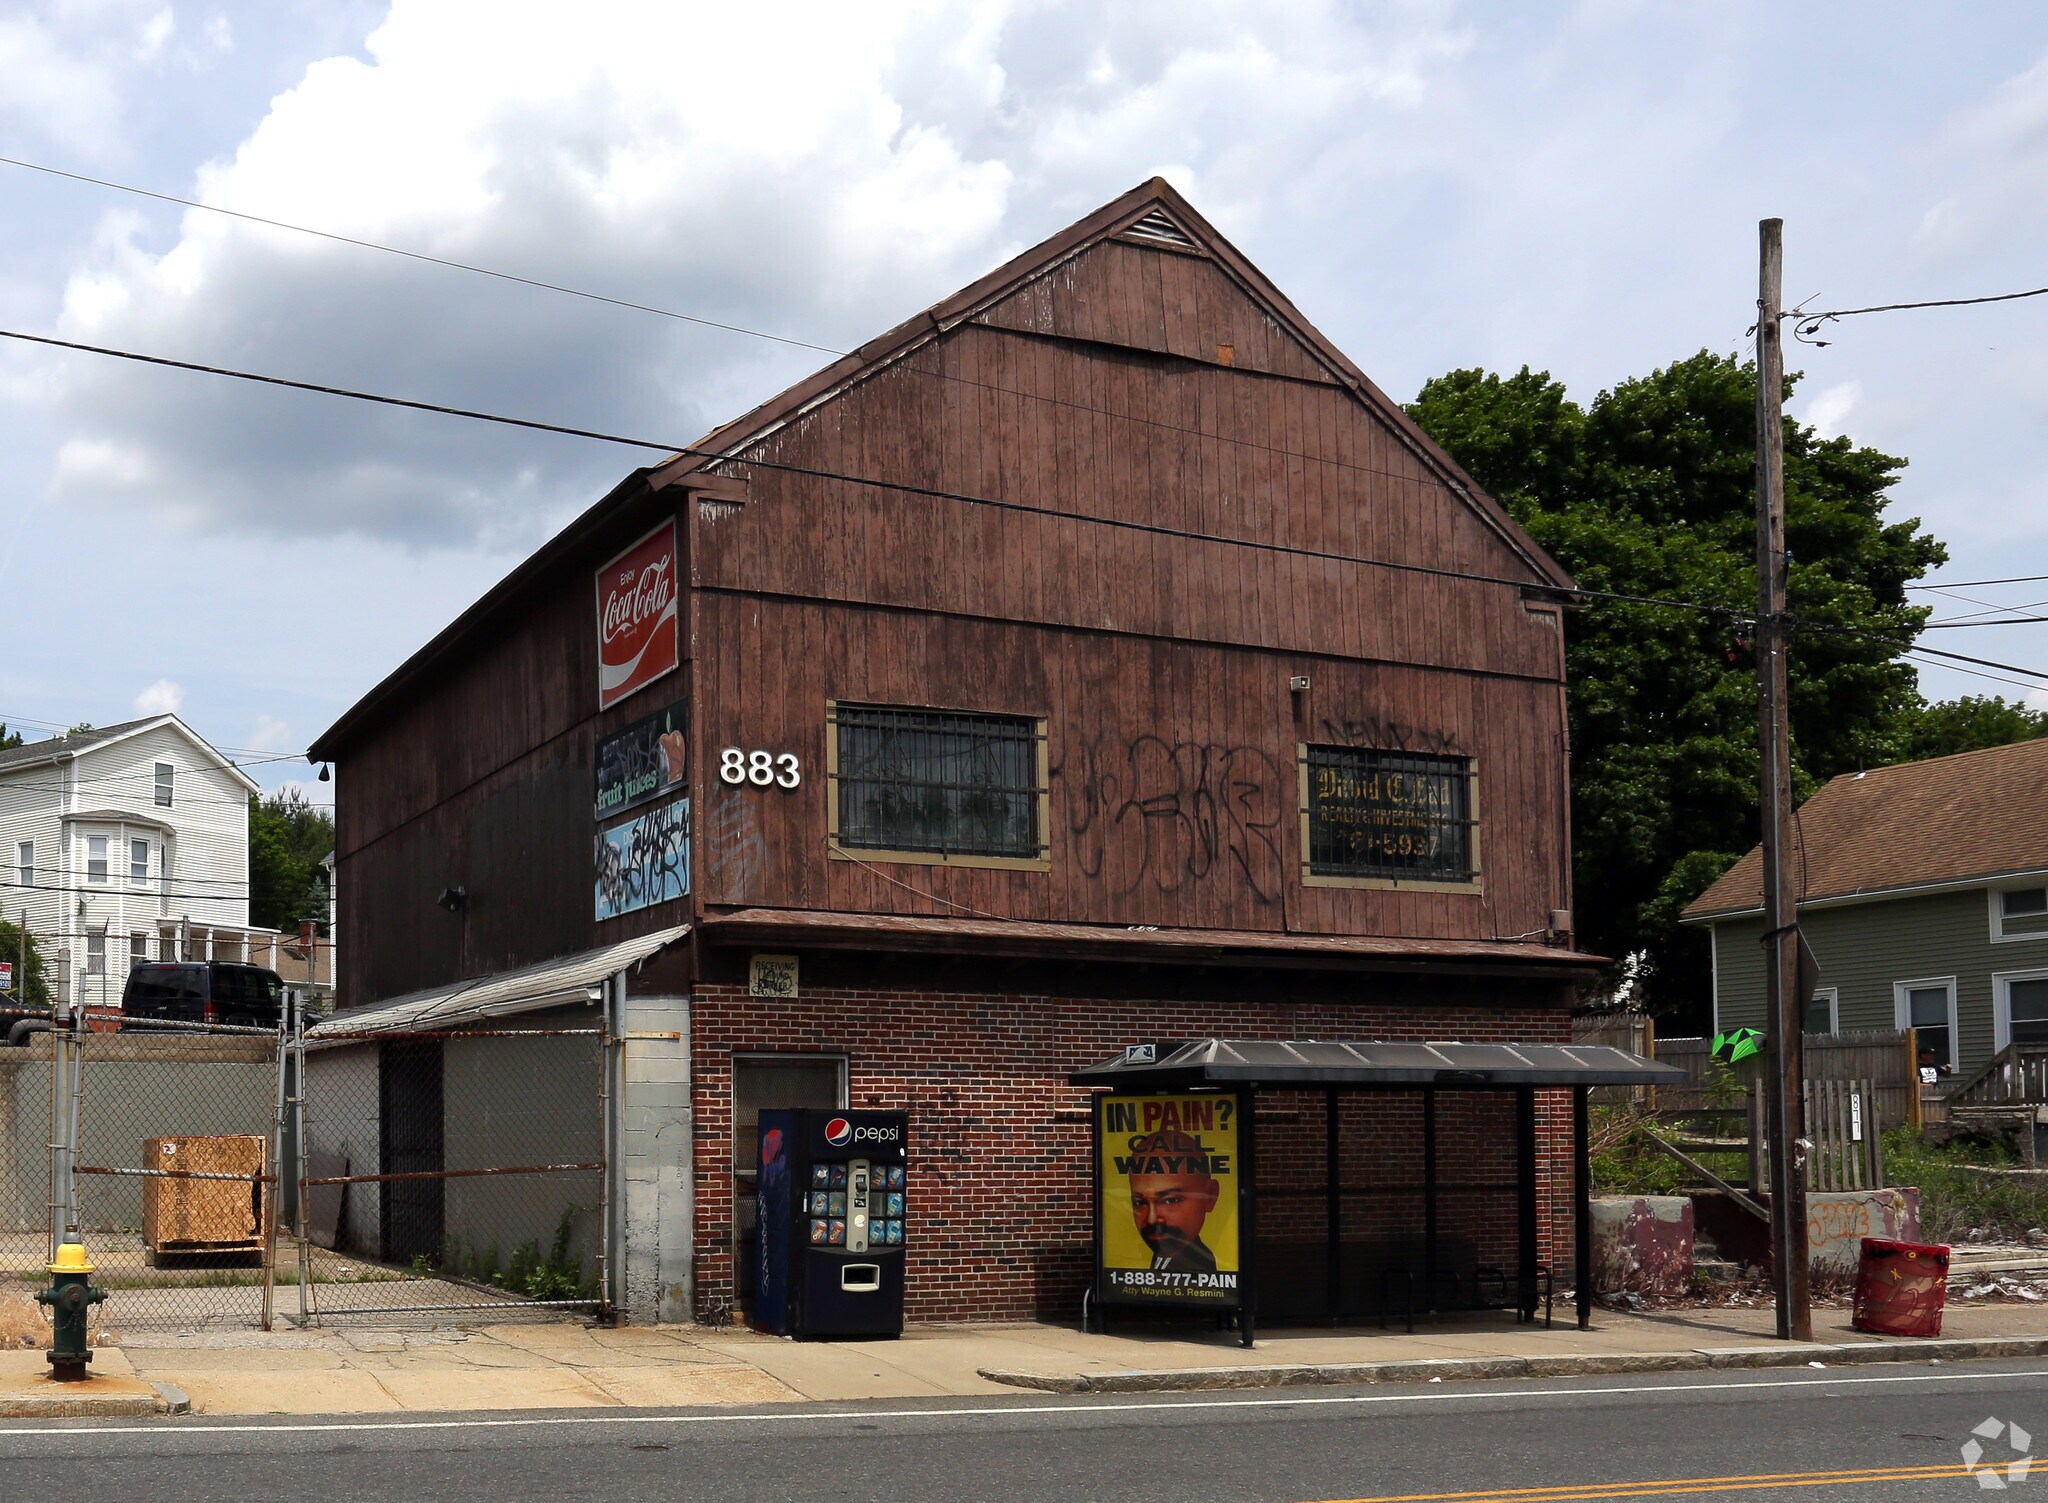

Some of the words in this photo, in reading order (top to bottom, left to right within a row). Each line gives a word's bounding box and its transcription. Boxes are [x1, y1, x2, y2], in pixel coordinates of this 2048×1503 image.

[620, 569, 636, 586] Enjoy
[603, 551, 672, 644] Coca-Cola
[720, 748, 801, 790] 883
[597, 781, 623, 811] fruit
[624, 770, 657, 805] juices
[1318, 767, 1379, 801] David
[755, 961, 795, 971] RECEIVING
[1106, 1102, 1137, 1133] IN
[1143, 1099, 1233, 1132] PAIN?
[1852, 1095, 1860, 1133] 877
[854, 1125, 899, 1143] pepsi
[1128, 1135, 1215, 1153] CALL
[1114, 1155, 1231, 1175] WAYNE
[1110, 1271, 1237, 1289] 1-888-777-PAIN
[1121, 1286, 1140, 1297] Atty
[1141, 1286, 1172, 1297] Wayne
[1174, 1288, 1185, 1296] G.
[1187, 1288, 1225, 1298] Resmini
